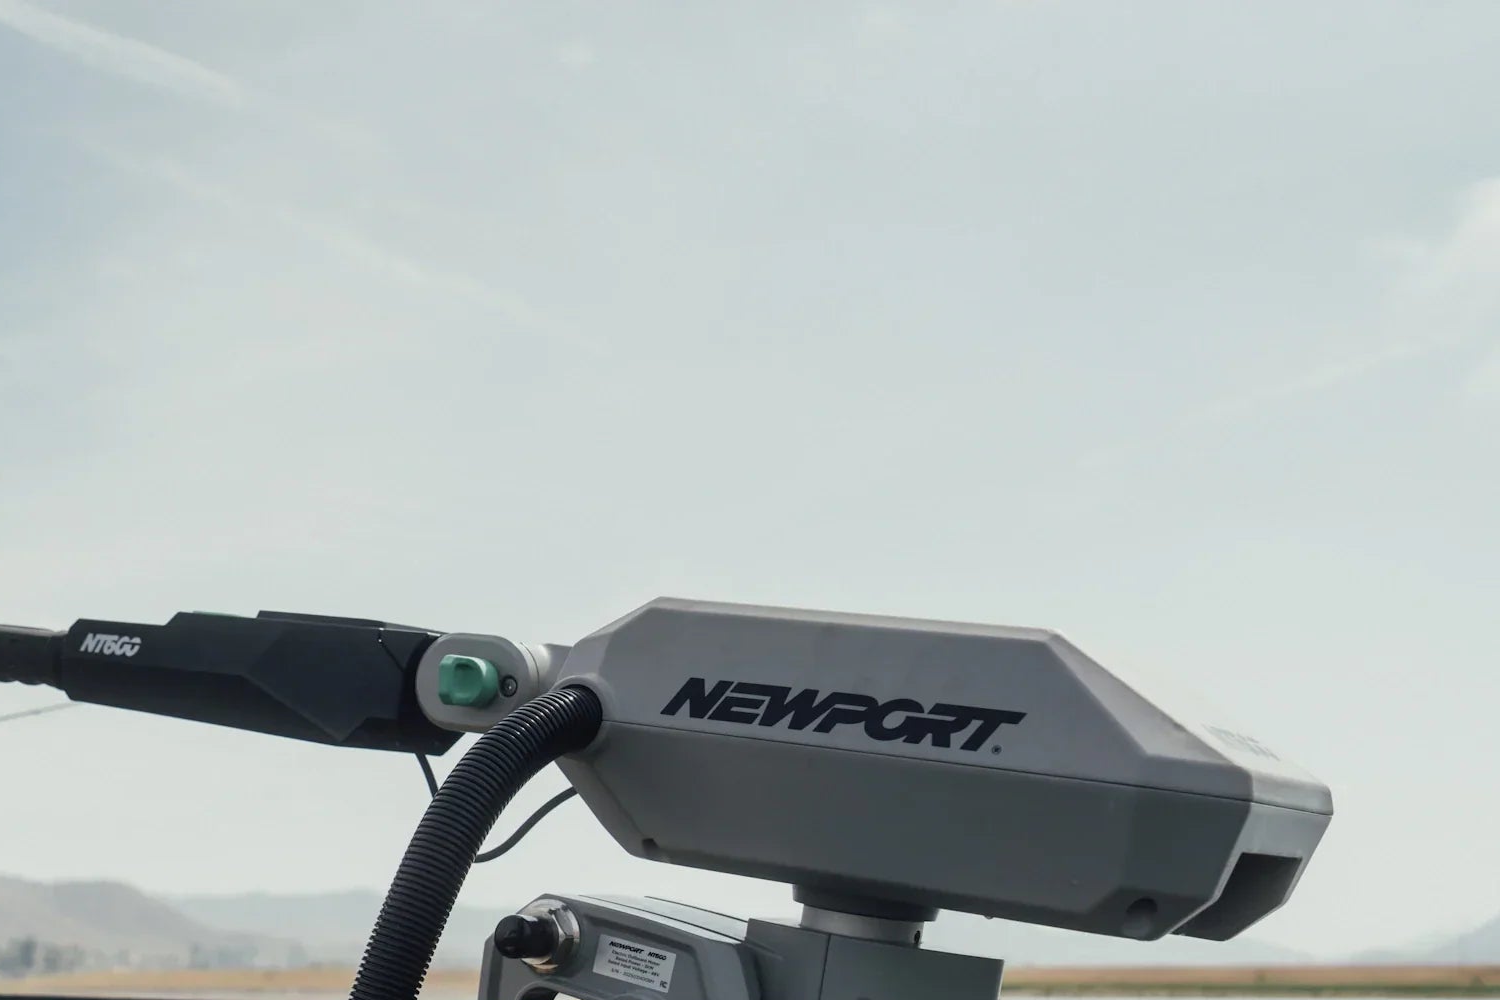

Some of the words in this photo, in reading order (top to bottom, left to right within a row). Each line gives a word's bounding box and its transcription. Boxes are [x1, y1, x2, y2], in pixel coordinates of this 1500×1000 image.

[660, 677, 1028, 751] NEWPORT
[609, 941, 645, 954] NEWPORT
[632, 966, 648, 974] Voltage
